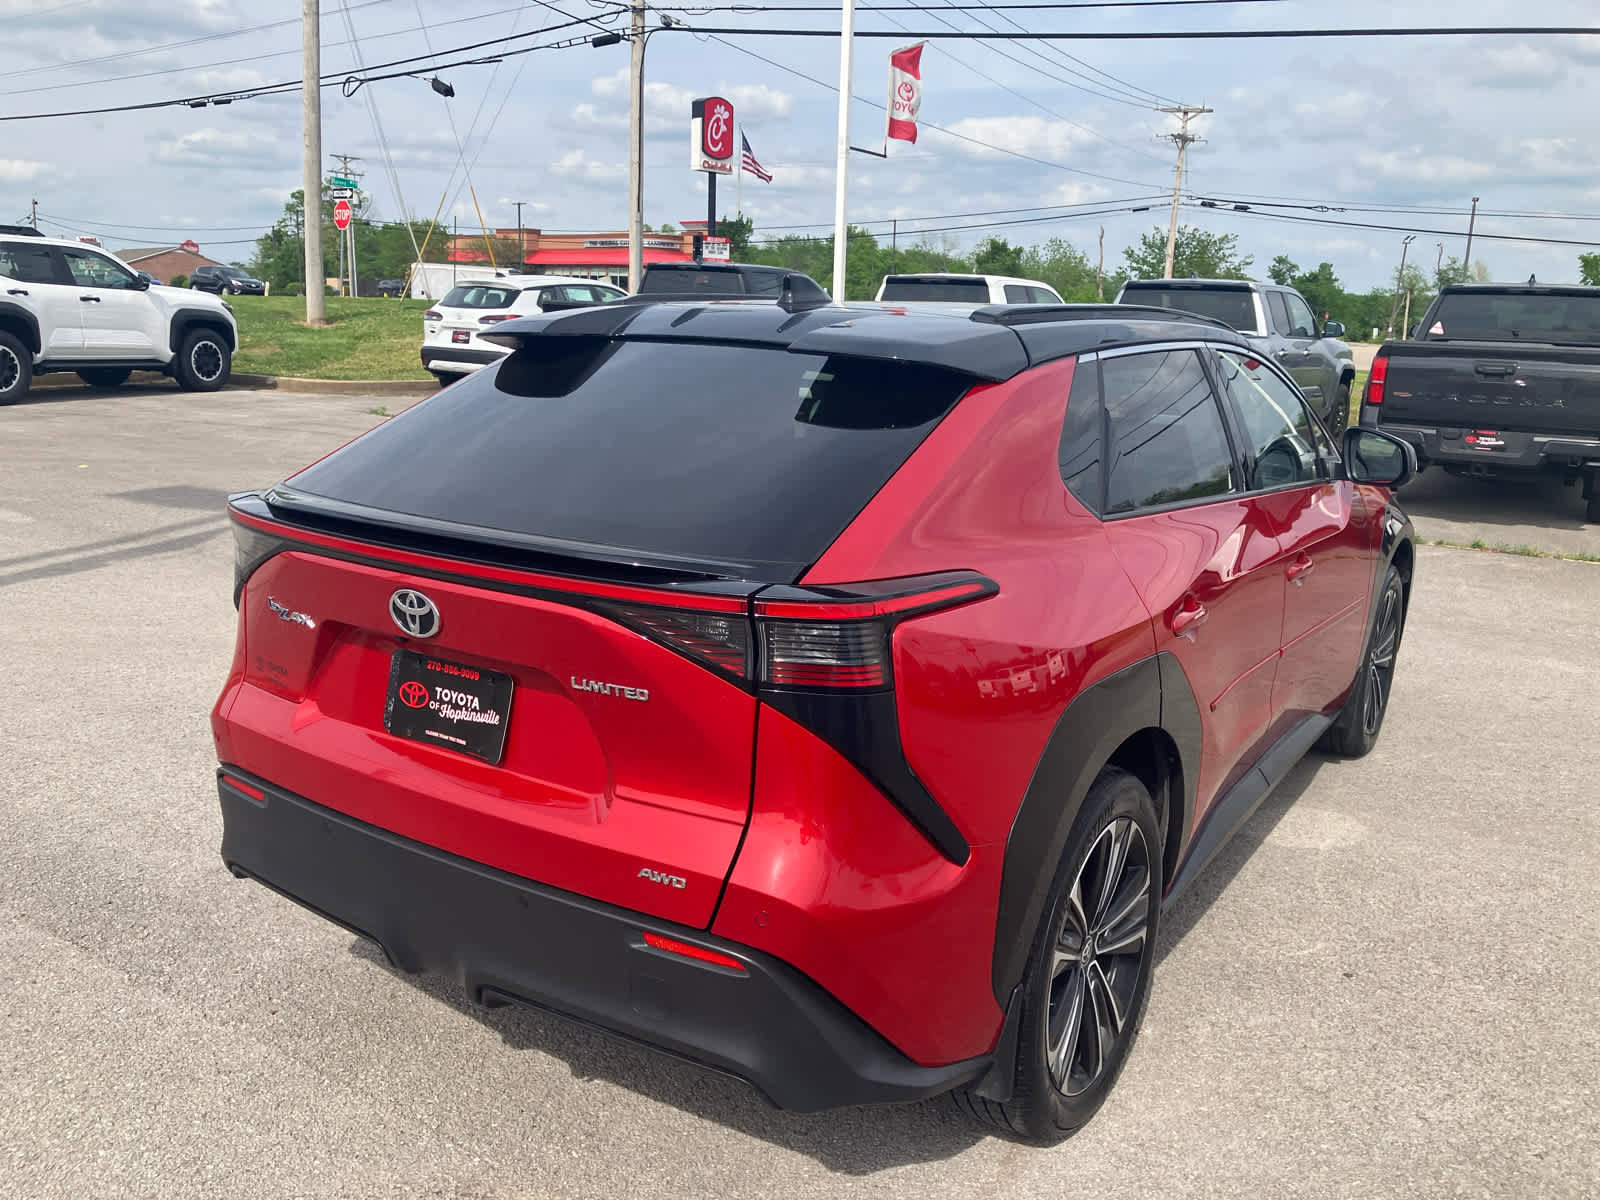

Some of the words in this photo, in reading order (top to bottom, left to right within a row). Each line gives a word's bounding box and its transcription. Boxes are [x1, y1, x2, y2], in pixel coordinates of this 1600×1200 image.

[335, 209, 350, 220] STOP
[435, 686, 480, 711] TOYOTA
[571, 676, 649, 702] LIMITED
[429, 700, 440, 710] OF
[439, 703, 500, 725] Hopkinsville
[637, 868, 687, 889] AWD
